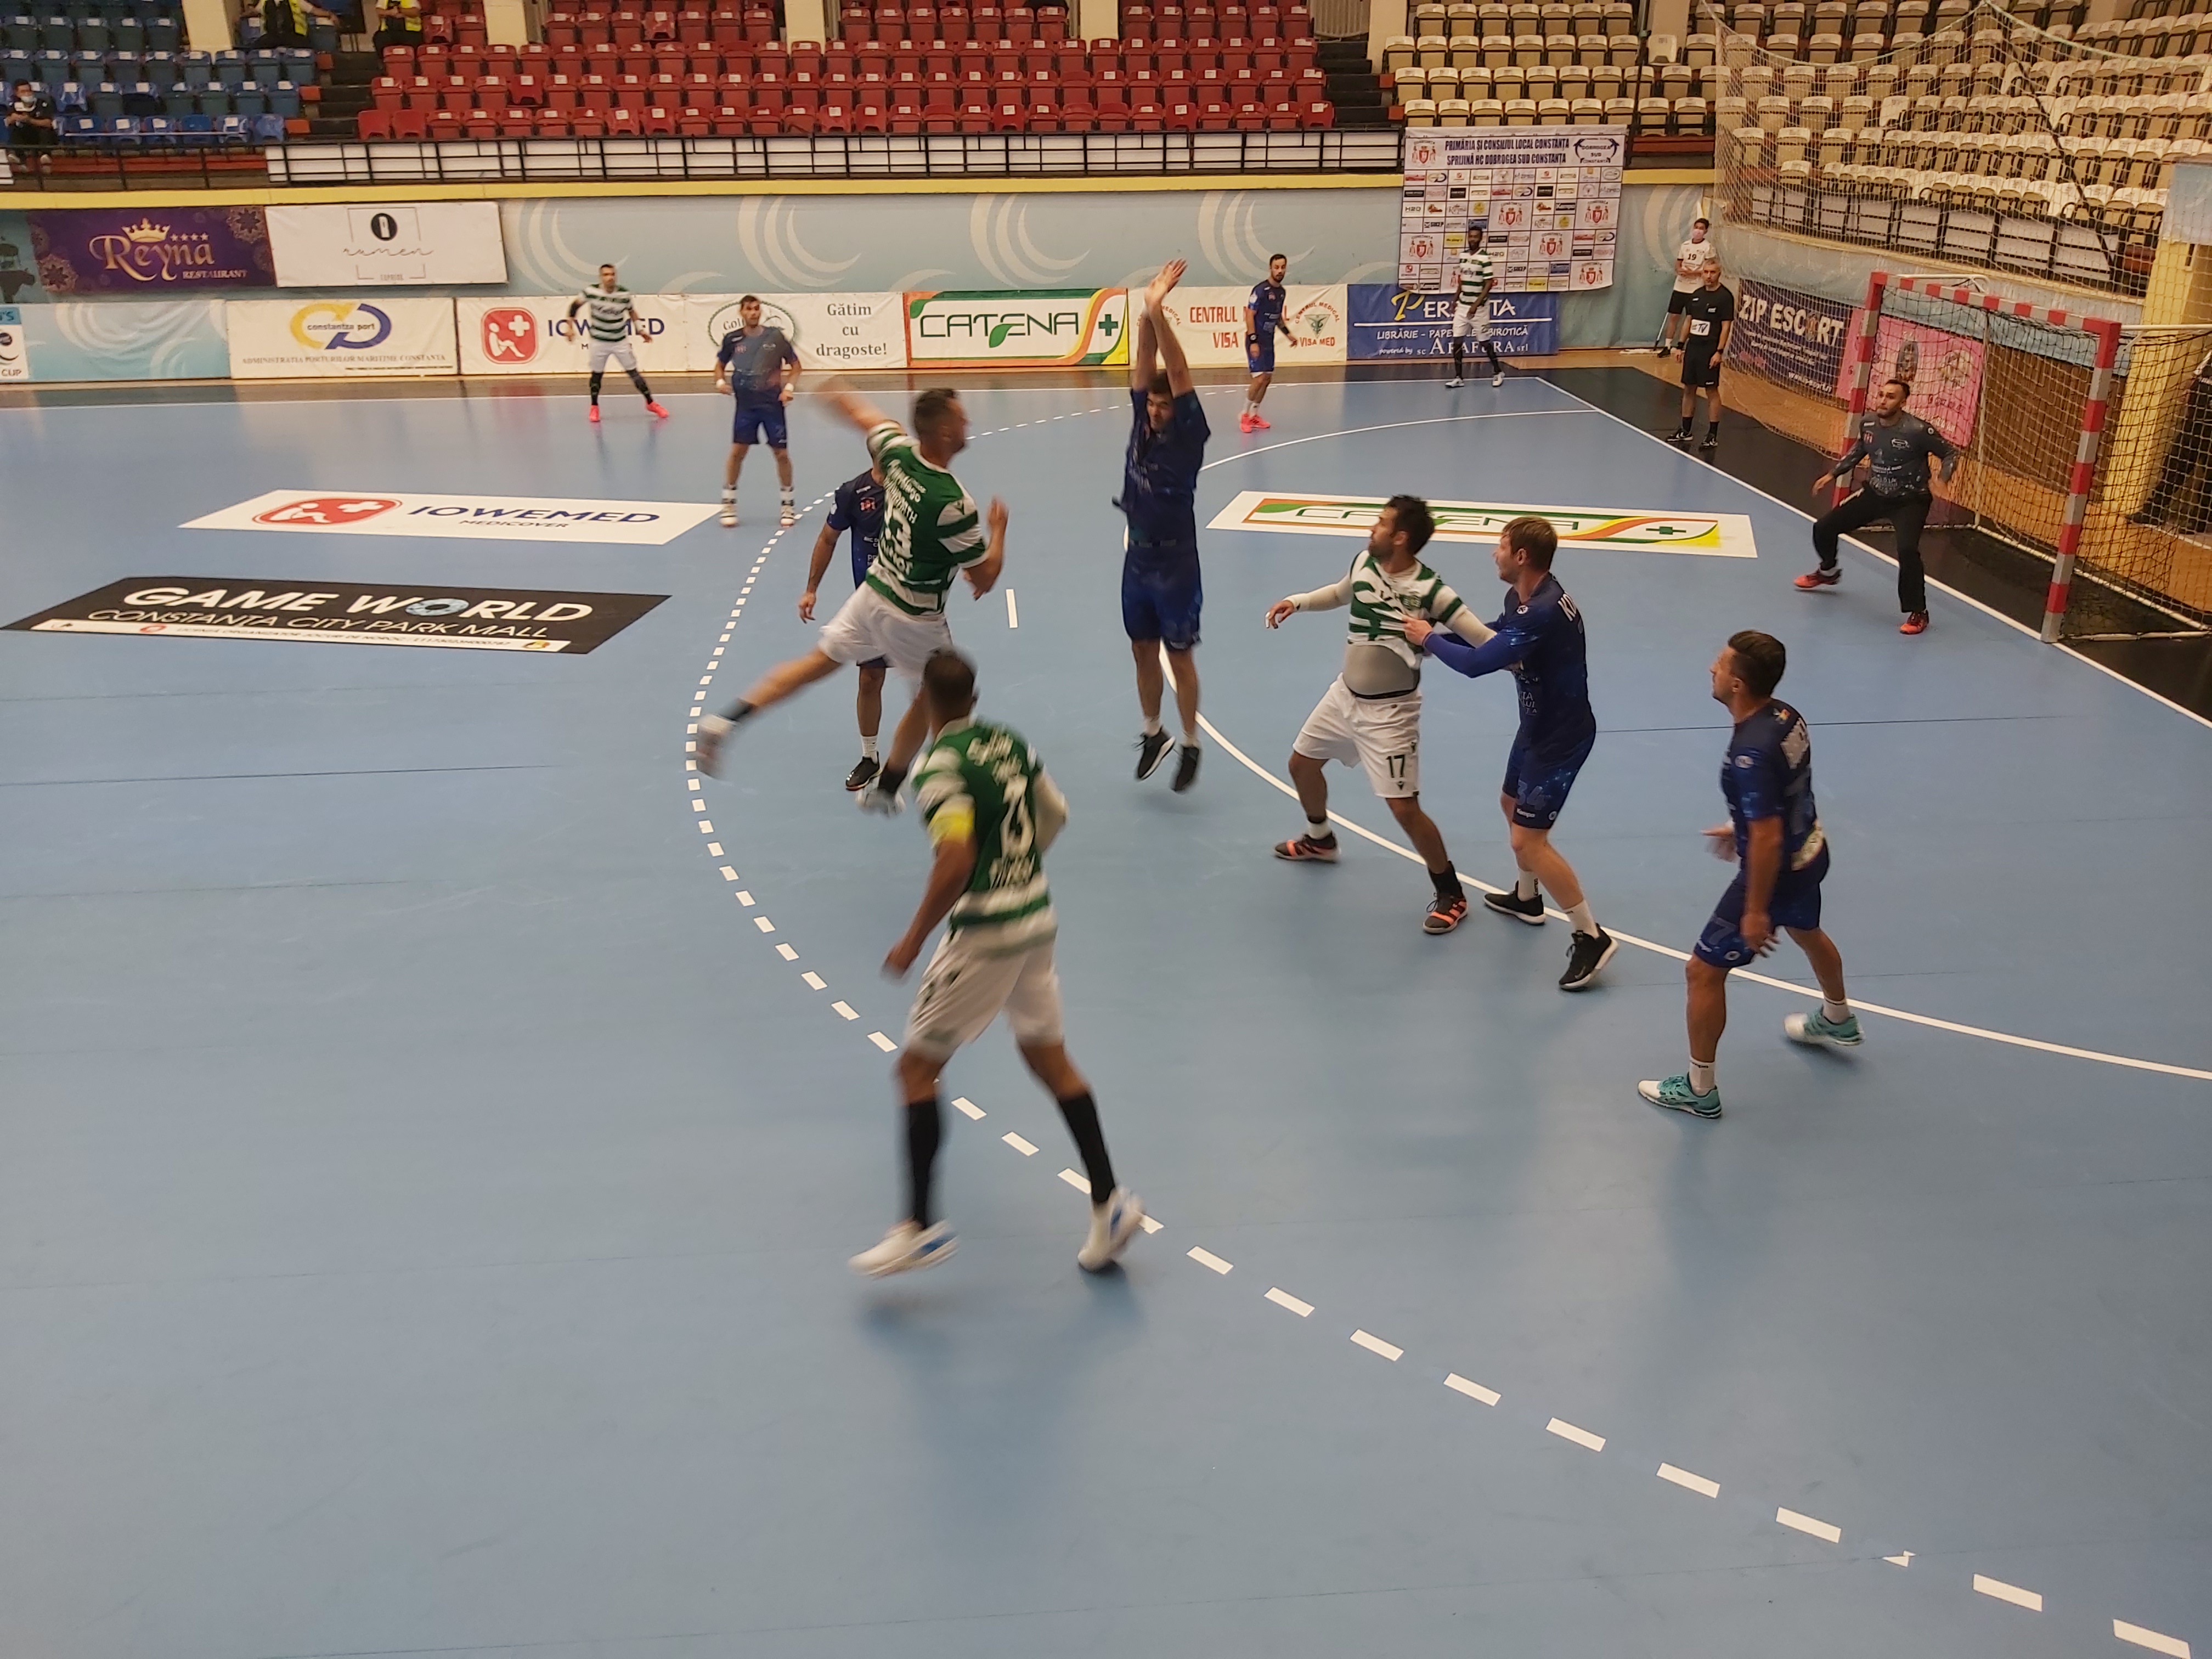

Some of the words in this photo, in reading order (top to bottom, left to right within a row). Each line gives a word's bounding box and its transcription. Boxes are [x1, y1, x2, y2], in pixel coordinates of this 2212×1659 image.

[1515, 138, 1533, 149] LOCAL
[1485, 154, 1516, 164] DOBROGEA
[1517, 154, 1530, 164] SUD
[88, 234, 215, 281] Reyna
[183, 269, 248, 279] RESTAURANT
[827, 303, 871, 316] Gătim
[1189, 306, 1238, 323] CENTRUL
[1295, 302, 1317, 324] CENTRUL
[1319, 302, 1340, 323] MEDICAL
[1739, 294, 1768, 323] ZIP
[842, 326, 859, 336] cu
[920, 312, 1079, 339] CATENA
[1212, 331, 1239, 348] VISA
[1299, 336, 1317, 347] VISA
[1319, 336, 1335, 347] MED
[816, 342, 887, 359] dragoste!
[407, 506, 661, 523] IOWEMED
[459, 520, 569, 528] MEDICOVER
[123, 586, 340, 611] GAME
[346, 595, 594, 622] WORLD
[287, 617, 365, 629] CITY
[364, 620, 458, 634] PARK
[458, 624, 548, 638] MALL
[1385, 754, 1406, 778] 17
